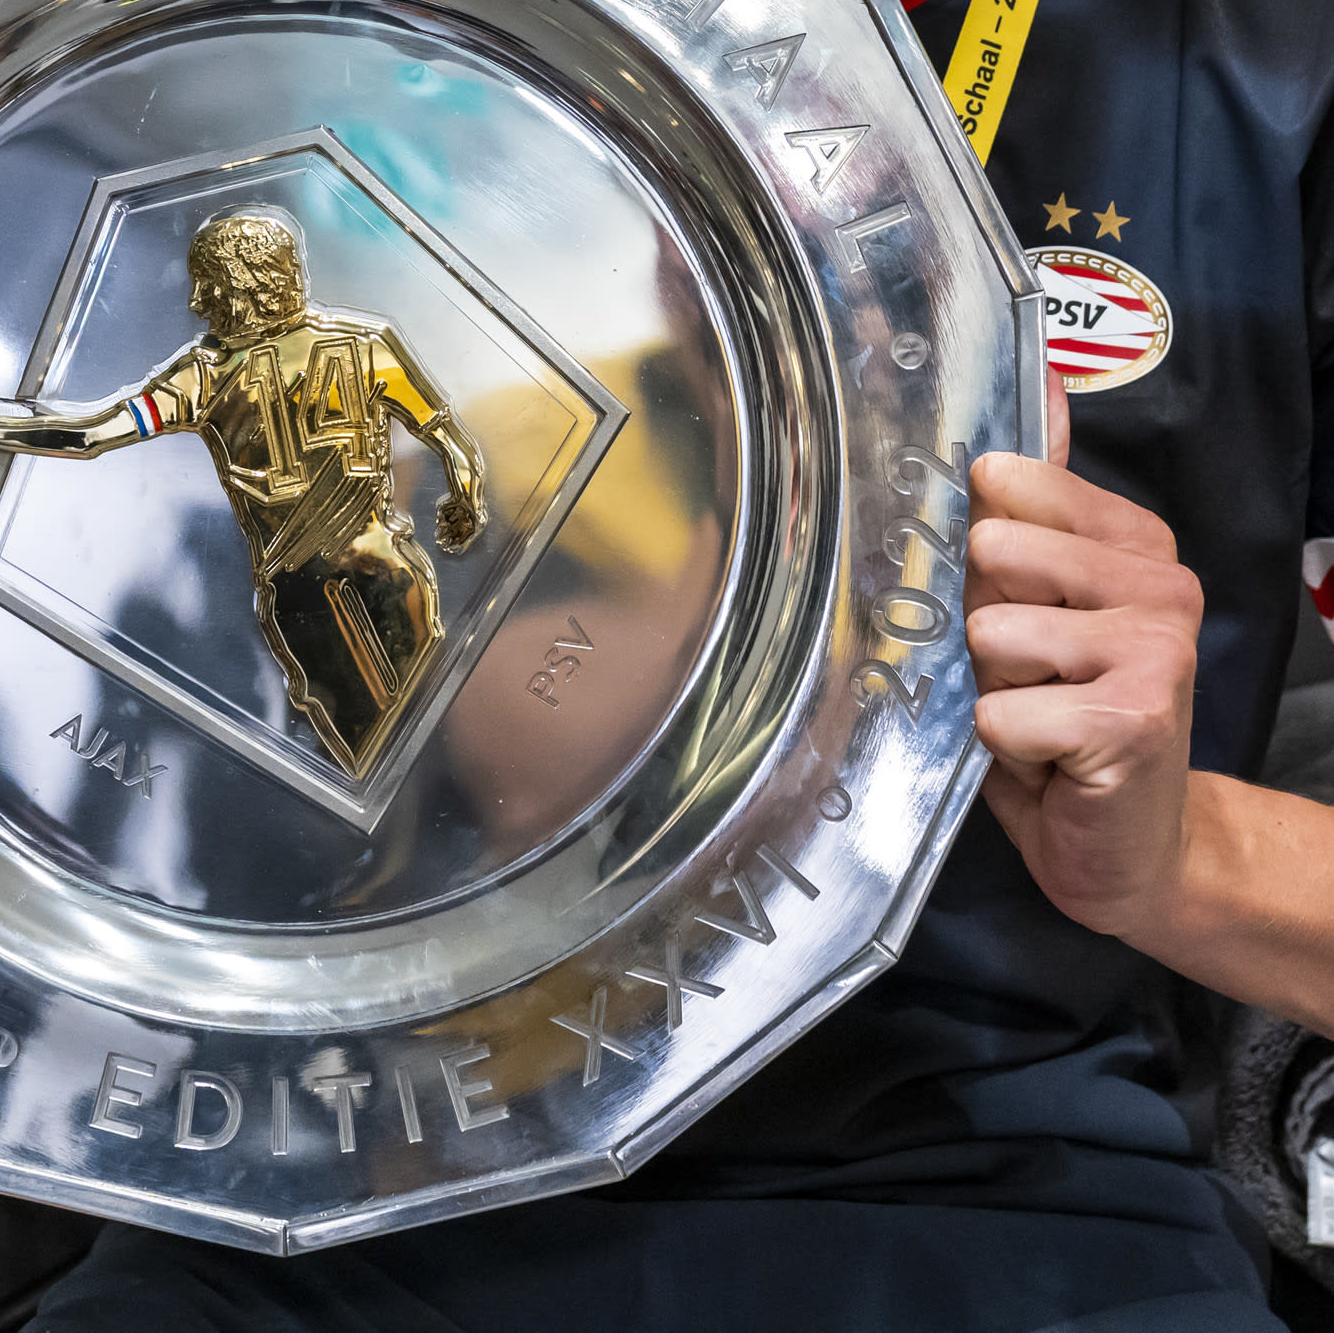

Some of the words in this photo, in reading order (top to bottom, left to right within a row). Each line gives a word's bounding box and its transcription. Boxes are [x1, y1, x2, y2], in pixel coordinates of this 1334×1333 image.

[957, 38, 1003, 136] Schaal
[244, 335, 379, 495] 14
[849, 441, 969, 731] 2022
[525, 615, 596, 710] PSV
[49, 712, 169, 799] AJAX
[89, 1043, 510, 1156] EDITIE
[549, 844, 821, 1087] XXVI
